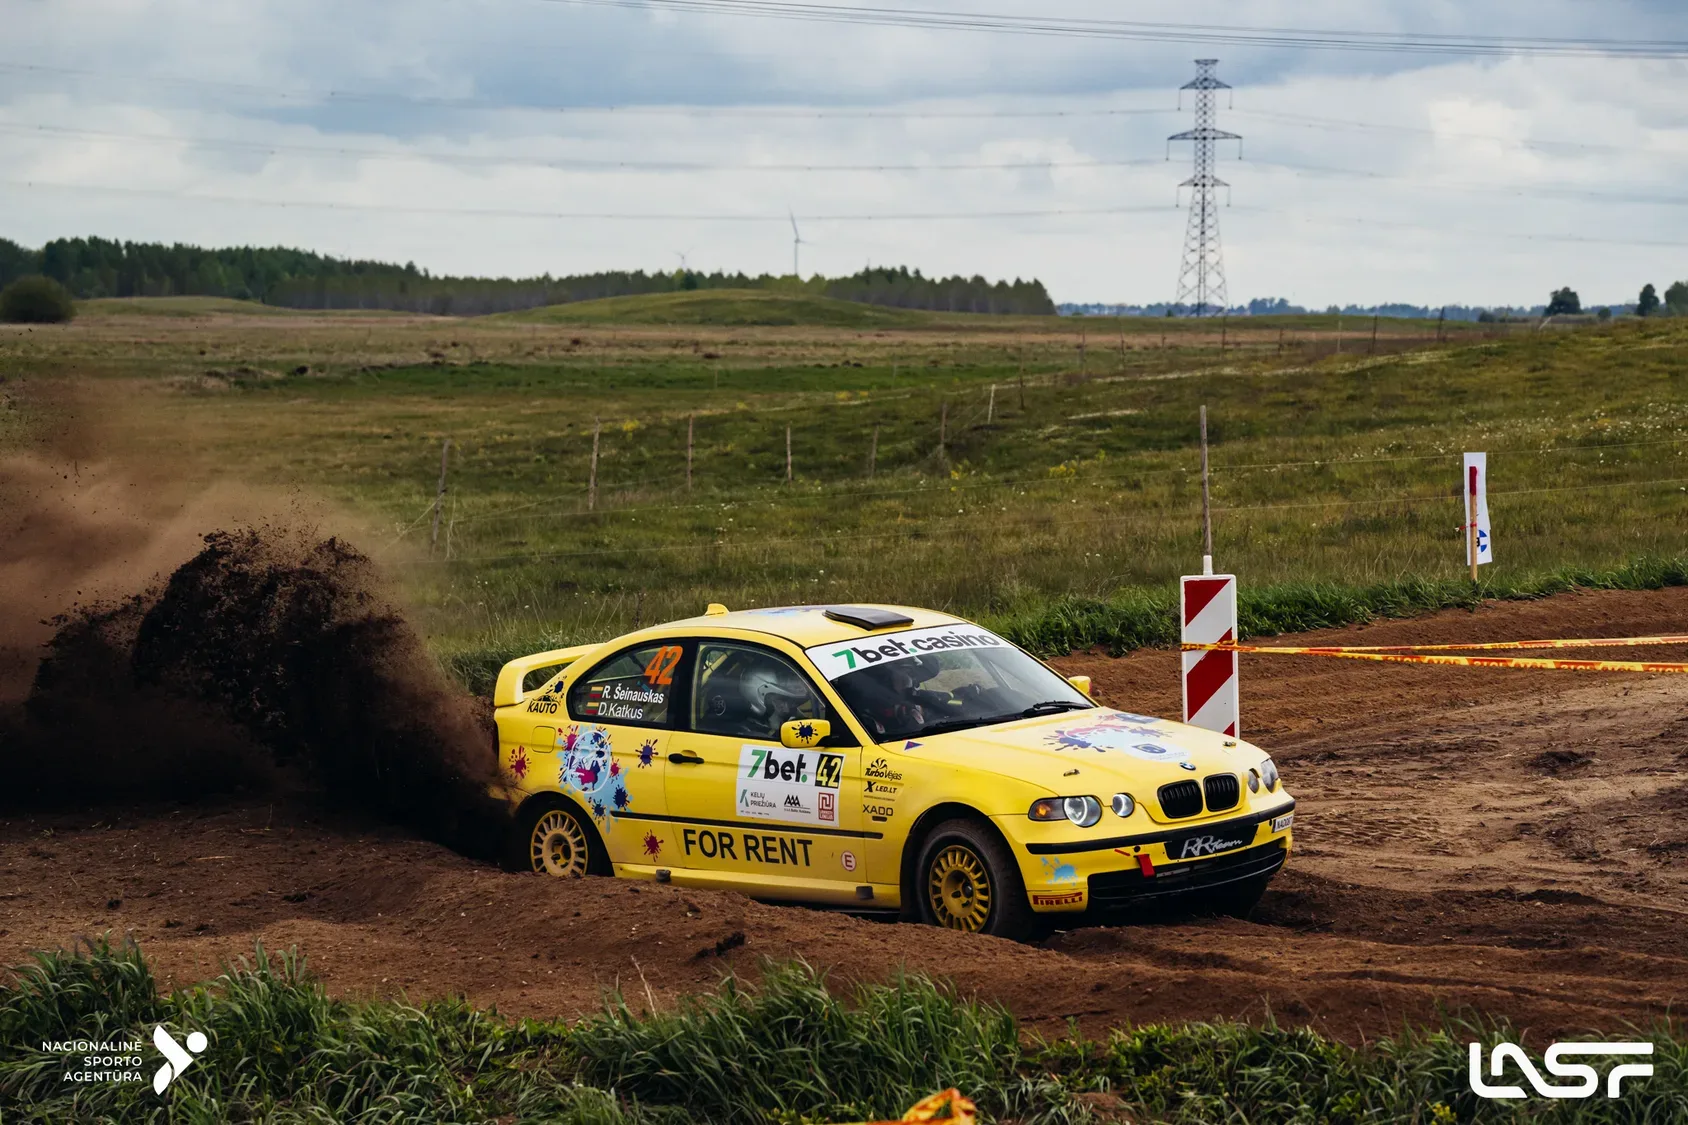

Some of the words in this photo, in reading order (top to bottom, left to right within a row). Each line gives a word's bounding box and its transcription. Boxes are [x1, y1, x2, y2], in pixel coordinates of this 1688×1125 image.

[644, 645, 684, 685] 42
[602, 686, 611, 698] R.
[613, 683, 665, 704] Šeinauskas
[526, 701, 558, 714] KAUTO
[815, 755, 843, 788] 42
[862, 804, 894, 817] XADO
[683, 828, 738, 860] FOR
[743, 833, 813, 867] RENT
[843, 854, 853, 868] E
[1032, 891, 1083, 906] PIRELLI
